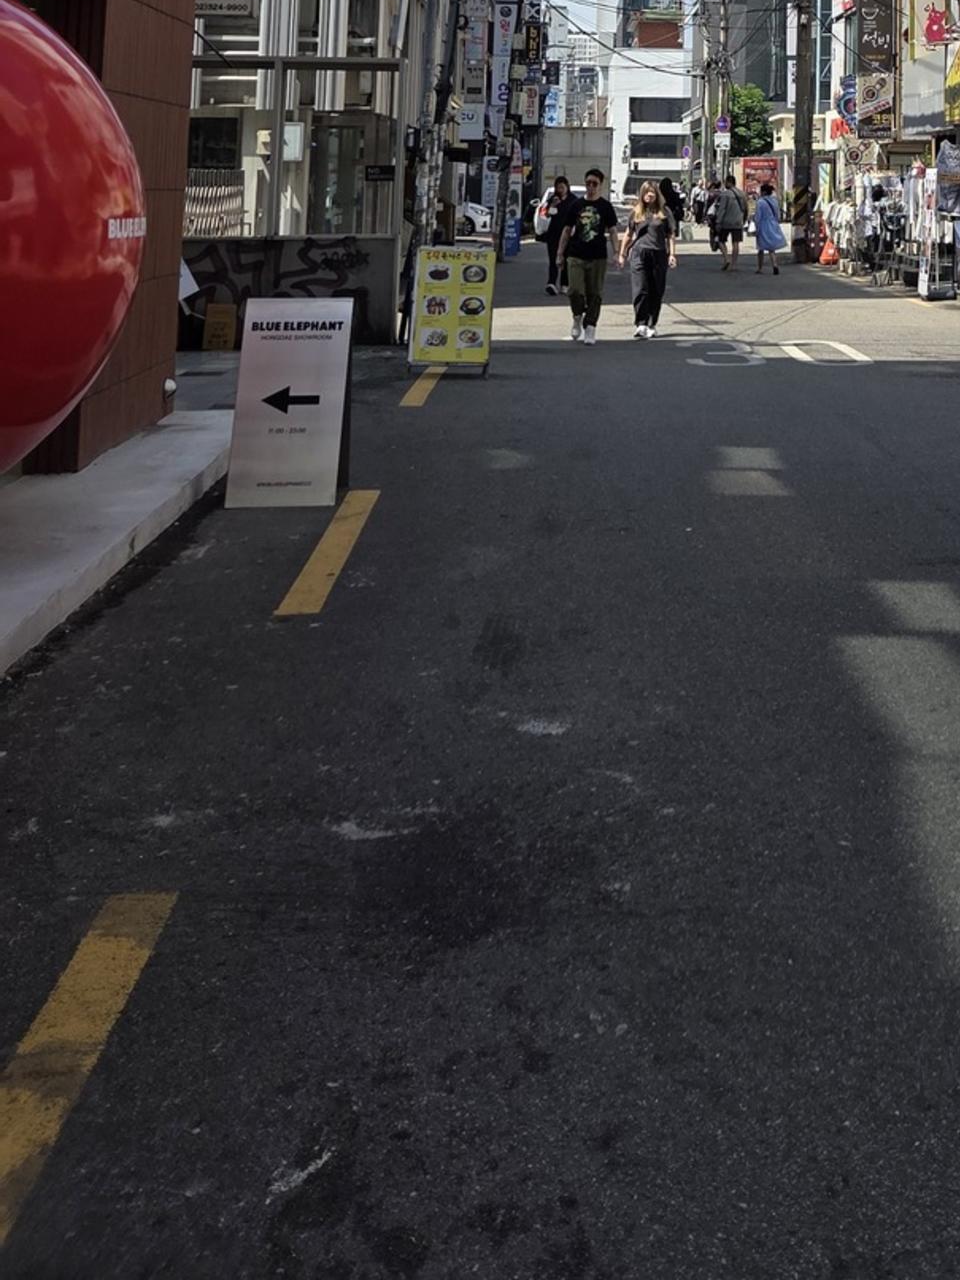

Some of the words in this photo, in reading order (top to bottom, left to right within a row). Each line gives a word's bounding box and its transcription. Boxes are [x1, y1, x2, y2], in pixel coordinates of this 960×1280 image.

[528, 25, 540, 59] bhc
[251, 320, 281, 332] BLUE
[282, 320, 344, 332] ELEPHANT
